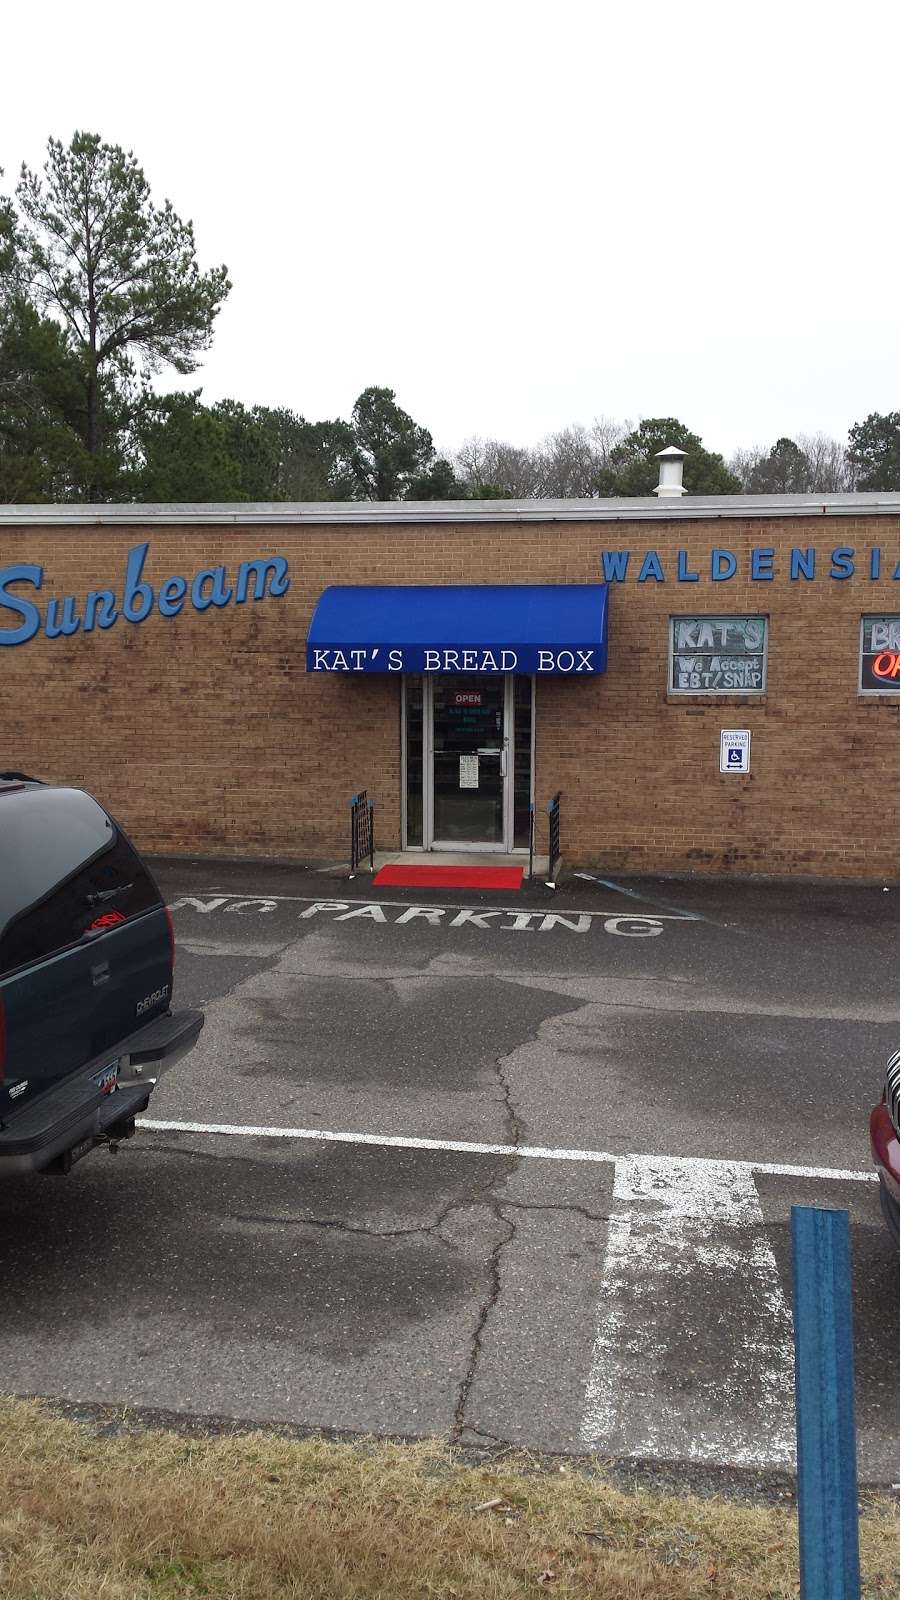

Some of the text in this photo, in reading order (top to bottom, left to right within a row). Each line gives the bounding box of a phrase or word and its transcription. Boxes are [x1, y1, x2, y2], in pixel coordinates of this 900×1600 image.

[601, 547, 900, 582] WALDENSI
[0, 543, 290, 646] Sunbeam
[677, 621, 760, 650] KAT'S
[313, 648, 594, 671] KAT'S BREAD BOX
[679, 656, 760, 674] We Accept
[456, 694, 481, 703] OPEN
[298, 902, 664, 937] PARKING
[136, 984, 169, 1013] CHEVROLET
